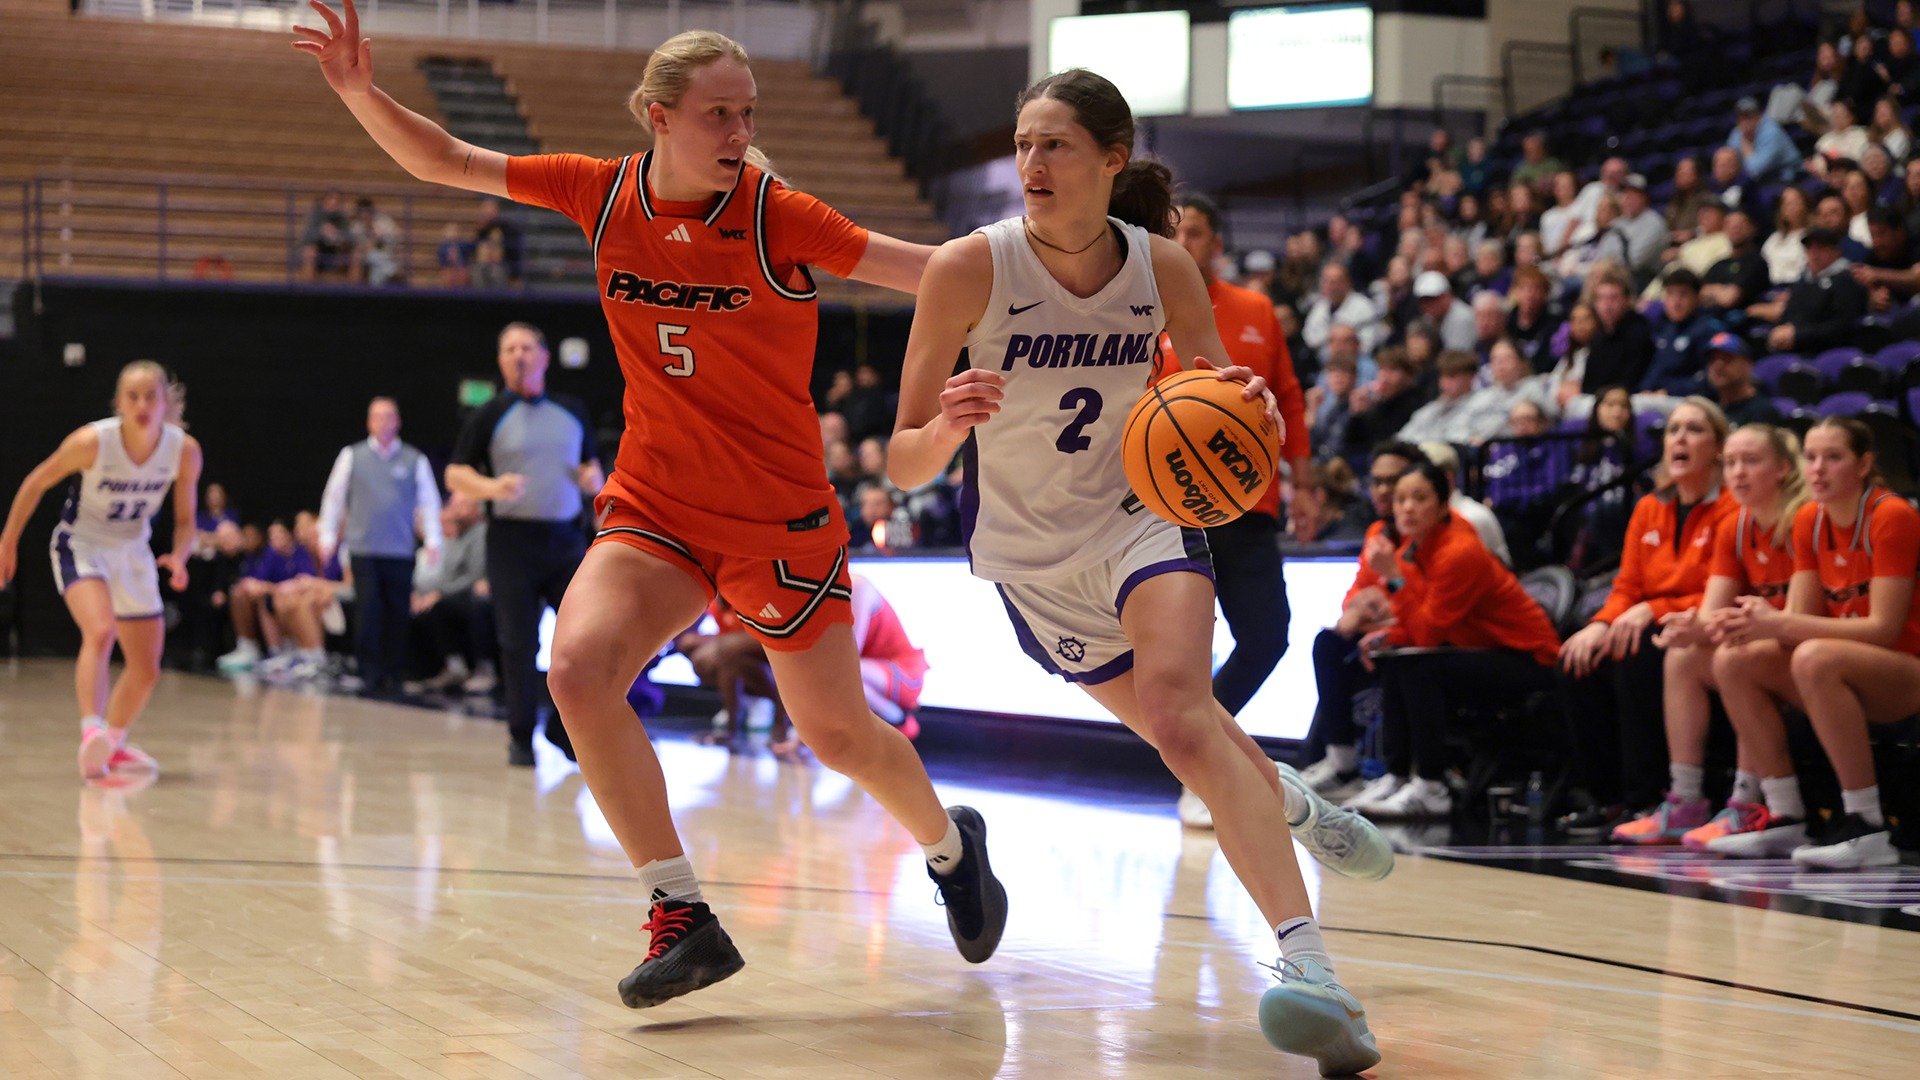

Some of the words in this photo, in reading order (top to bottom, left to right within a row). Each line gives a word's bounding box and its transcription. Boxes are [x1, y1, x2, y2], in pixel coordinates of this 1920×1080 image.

[606, 269, 752, 312] PACIFIC
[656, 322, 696, 378] 5
[1056, 387, 1103, 454] 2
[1166, 447, 1230, 525] Wilson
[1206, 428, 1263, 495] NCAA
